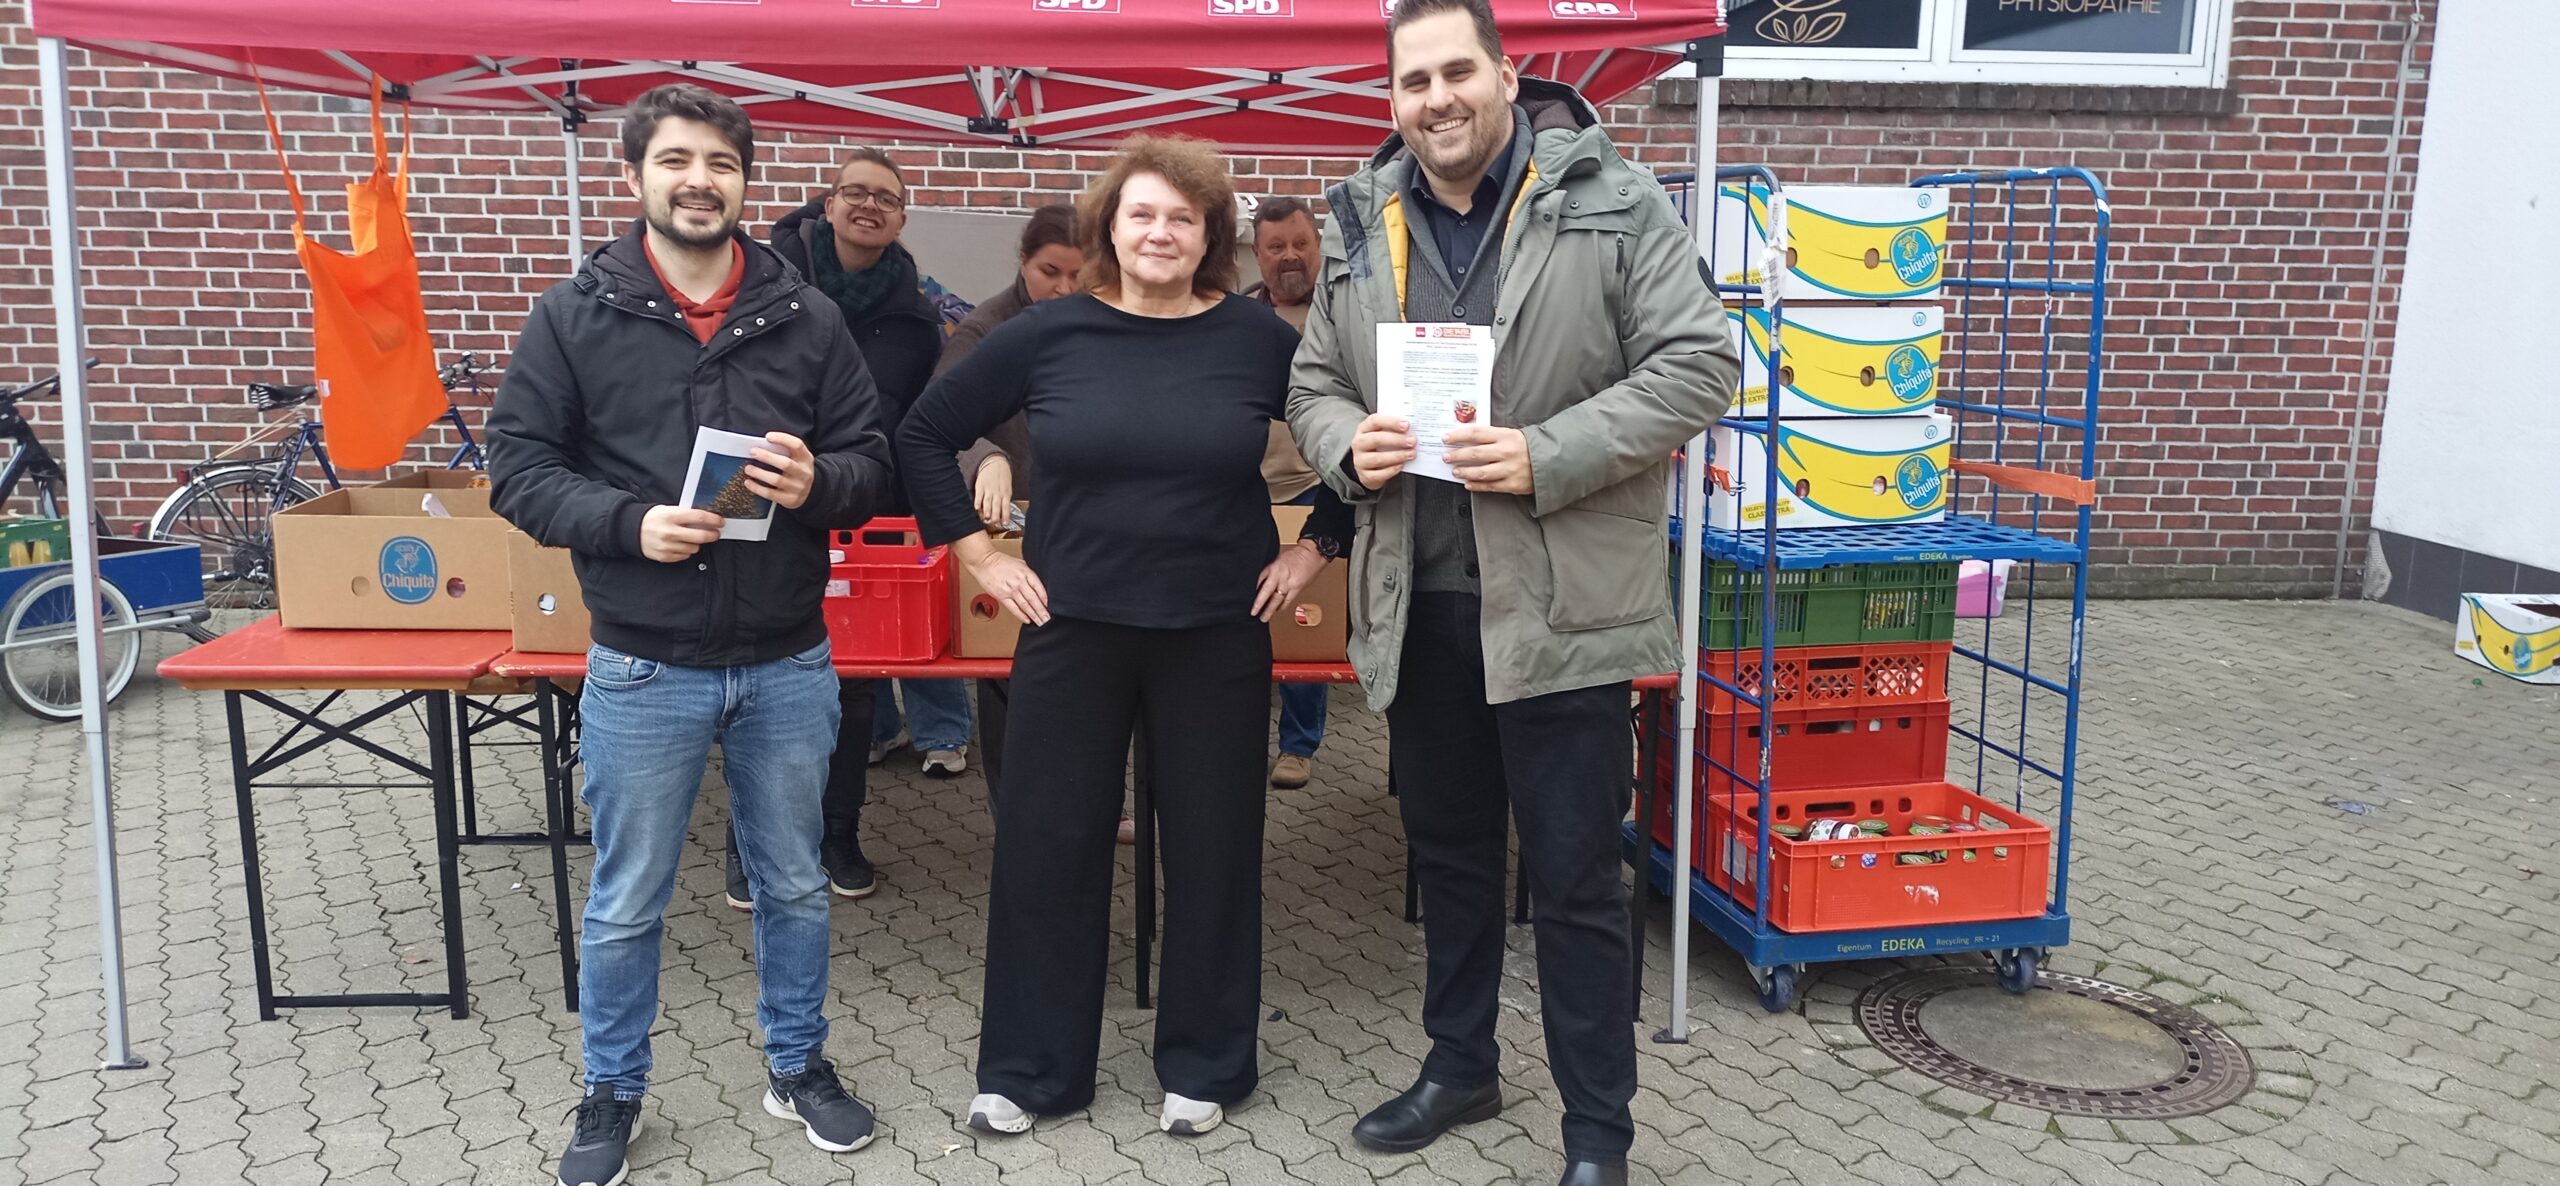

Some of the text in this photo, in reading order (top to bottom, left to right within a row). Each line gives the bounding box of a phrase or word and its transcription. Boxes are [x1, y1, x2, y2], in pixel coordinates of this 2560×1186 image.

[1212, 0, 1280, 15] SPD
[1898, 250, 1938, 281] Chiquita
[1893, 368, 1933, 397] Chiquita
[1903, 475, 1941, 505] Chiquita
[1919, 552, 1948, 560] EDEKA
[382, 573, 435, 593] Chiquita
[1837, 944, 1872, 953] Eigentum
[1881, 938, 1925, 952] EDEKA
[1936, 936, 1970, 946] Recycling
